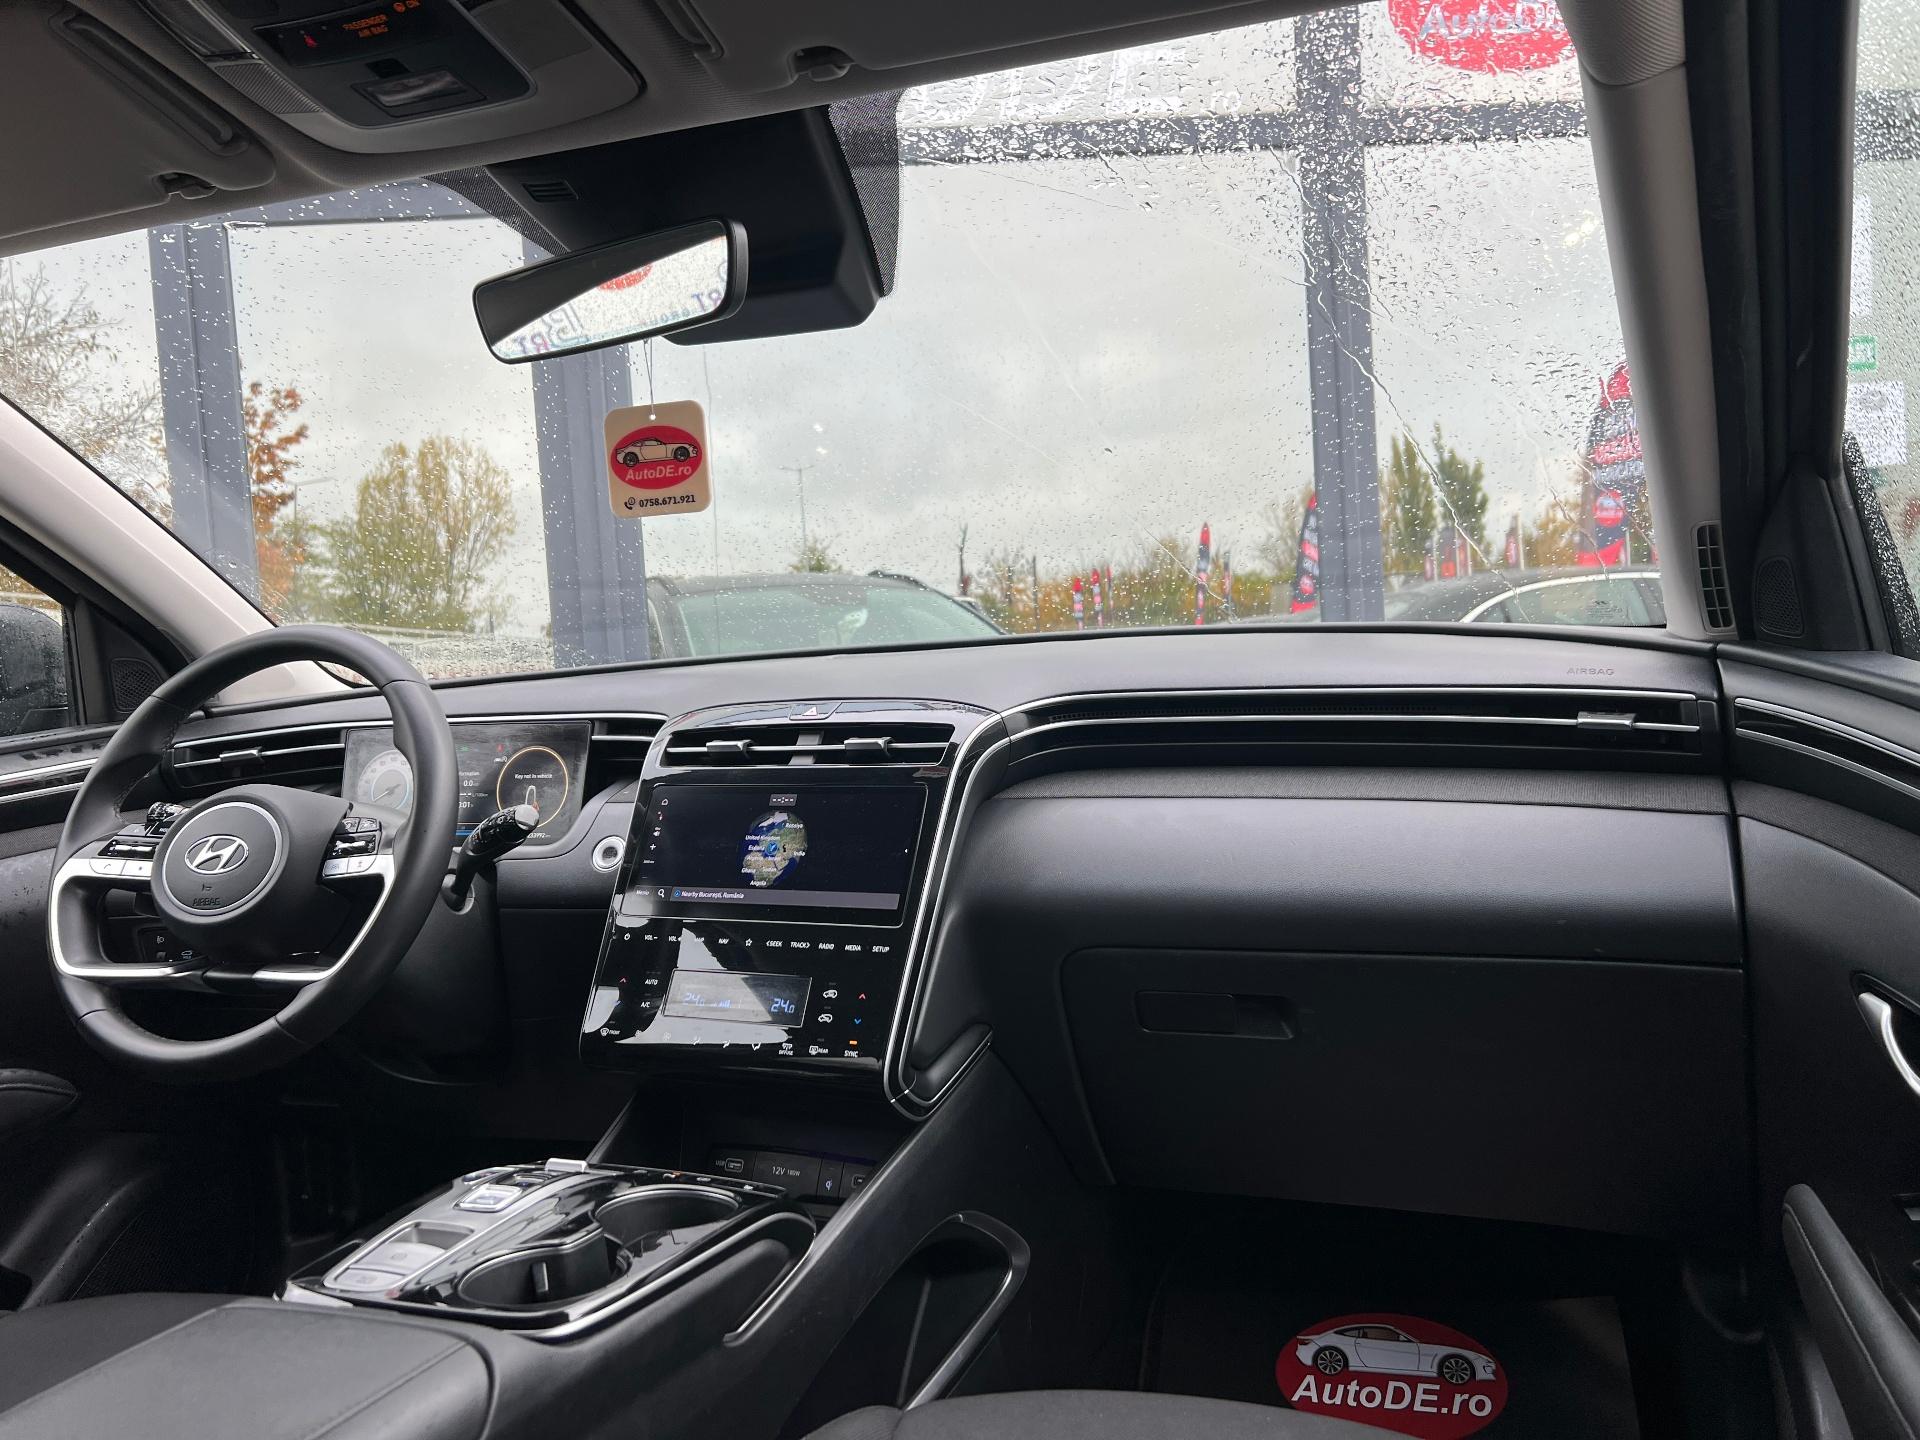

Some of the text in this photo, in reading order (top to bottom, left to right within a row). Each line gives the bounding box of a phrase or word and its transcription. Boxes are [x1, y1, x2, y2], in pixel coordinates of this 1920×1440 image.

[342, 14, 387, 30] PASSENGER
[625, 465, 692, 481] AutoDE.ro
[639, 494, 696, 508] 0758.671.921
[1566, 667, 1615, 676] AIRBAG
[770, 998, 795, 1014] 24.0
[772, 1166, 786, 1176] 12V
[1291, 1374, 1493, 1418] AutoDE.ro
